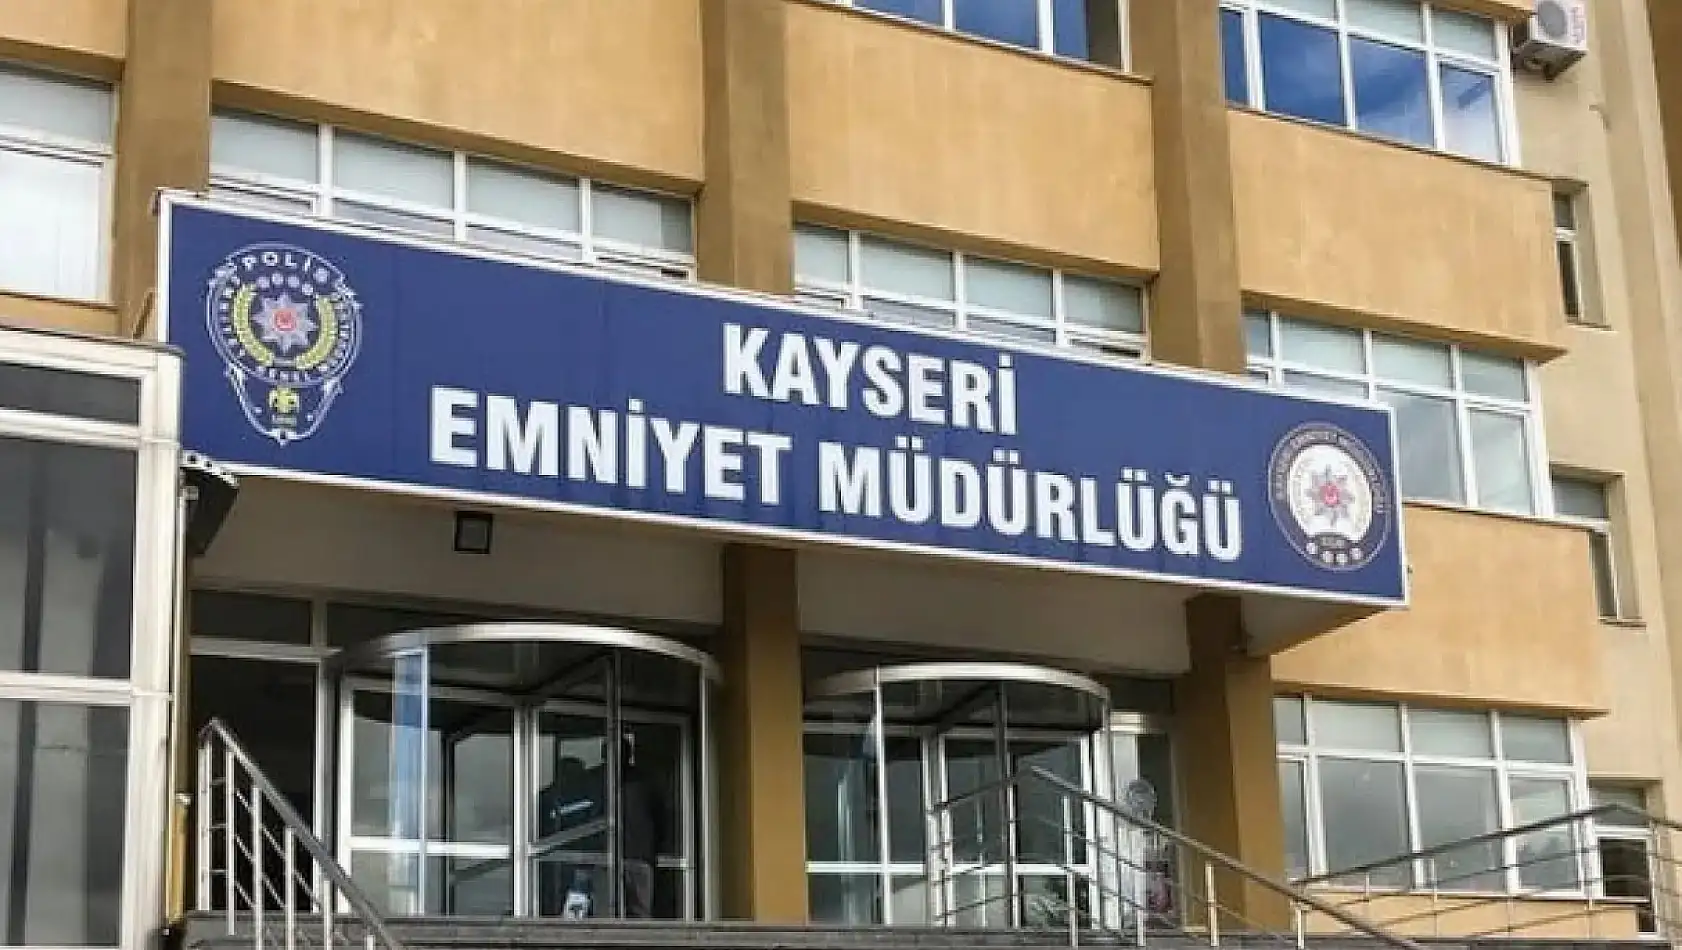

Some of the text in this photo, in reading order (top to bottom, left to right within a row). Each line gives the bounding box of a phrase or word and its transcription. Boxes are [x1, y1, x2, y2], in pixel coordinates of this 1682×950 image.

[722, 322, 1017, 437] KAYSERİ
[430, 387, 793, 507] EMNİYET
[818, 434, 1243, 562] MÜDÜRLÜĞÜ
